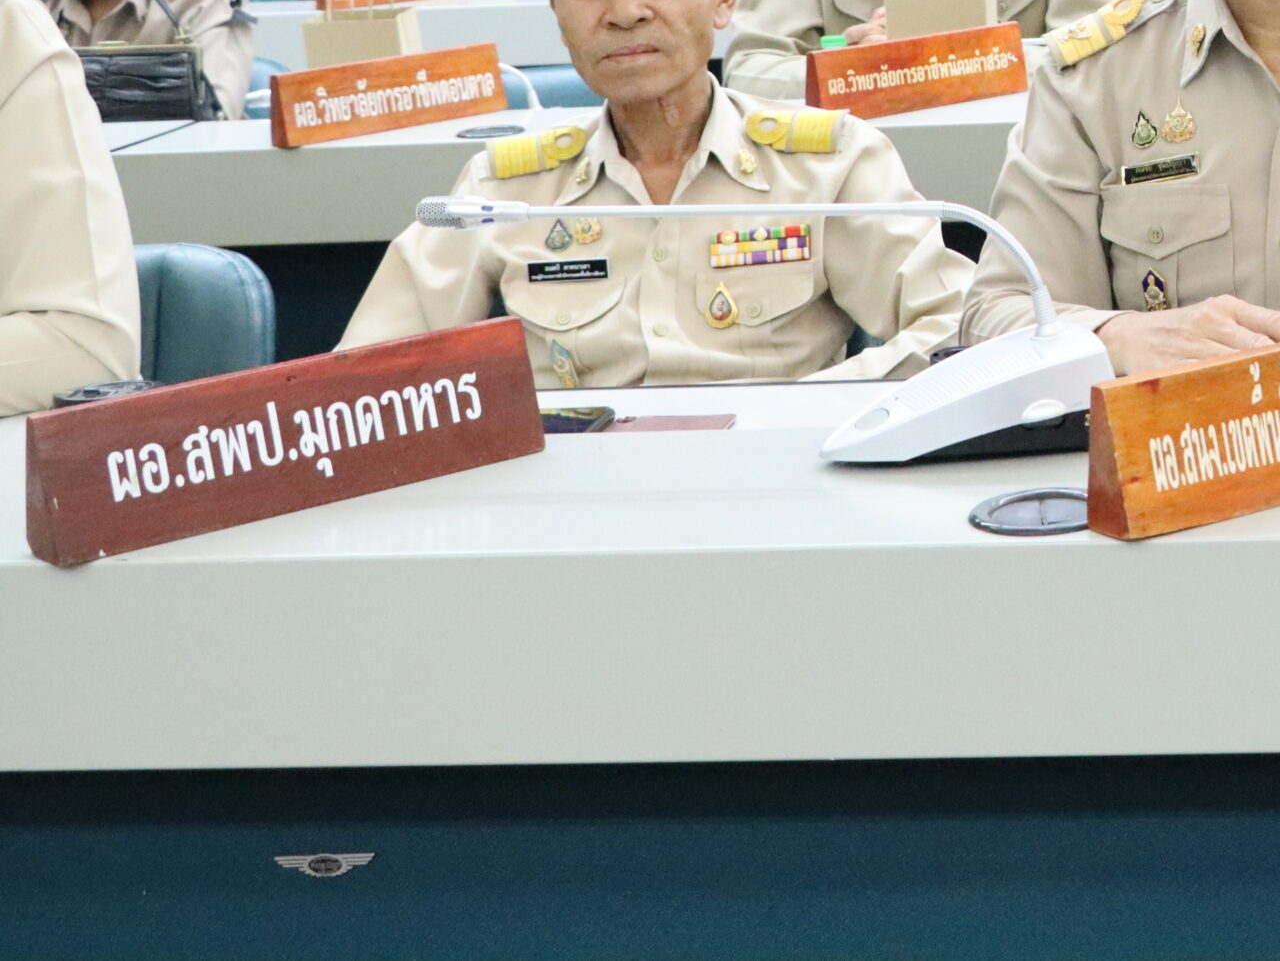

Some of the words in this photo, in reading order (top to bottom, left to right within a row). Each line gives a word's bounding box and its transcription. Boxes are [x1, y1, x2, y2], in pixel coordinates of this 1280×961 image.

[107, 372, 482, 502] ผอ.สพป.มุกดาหาร
